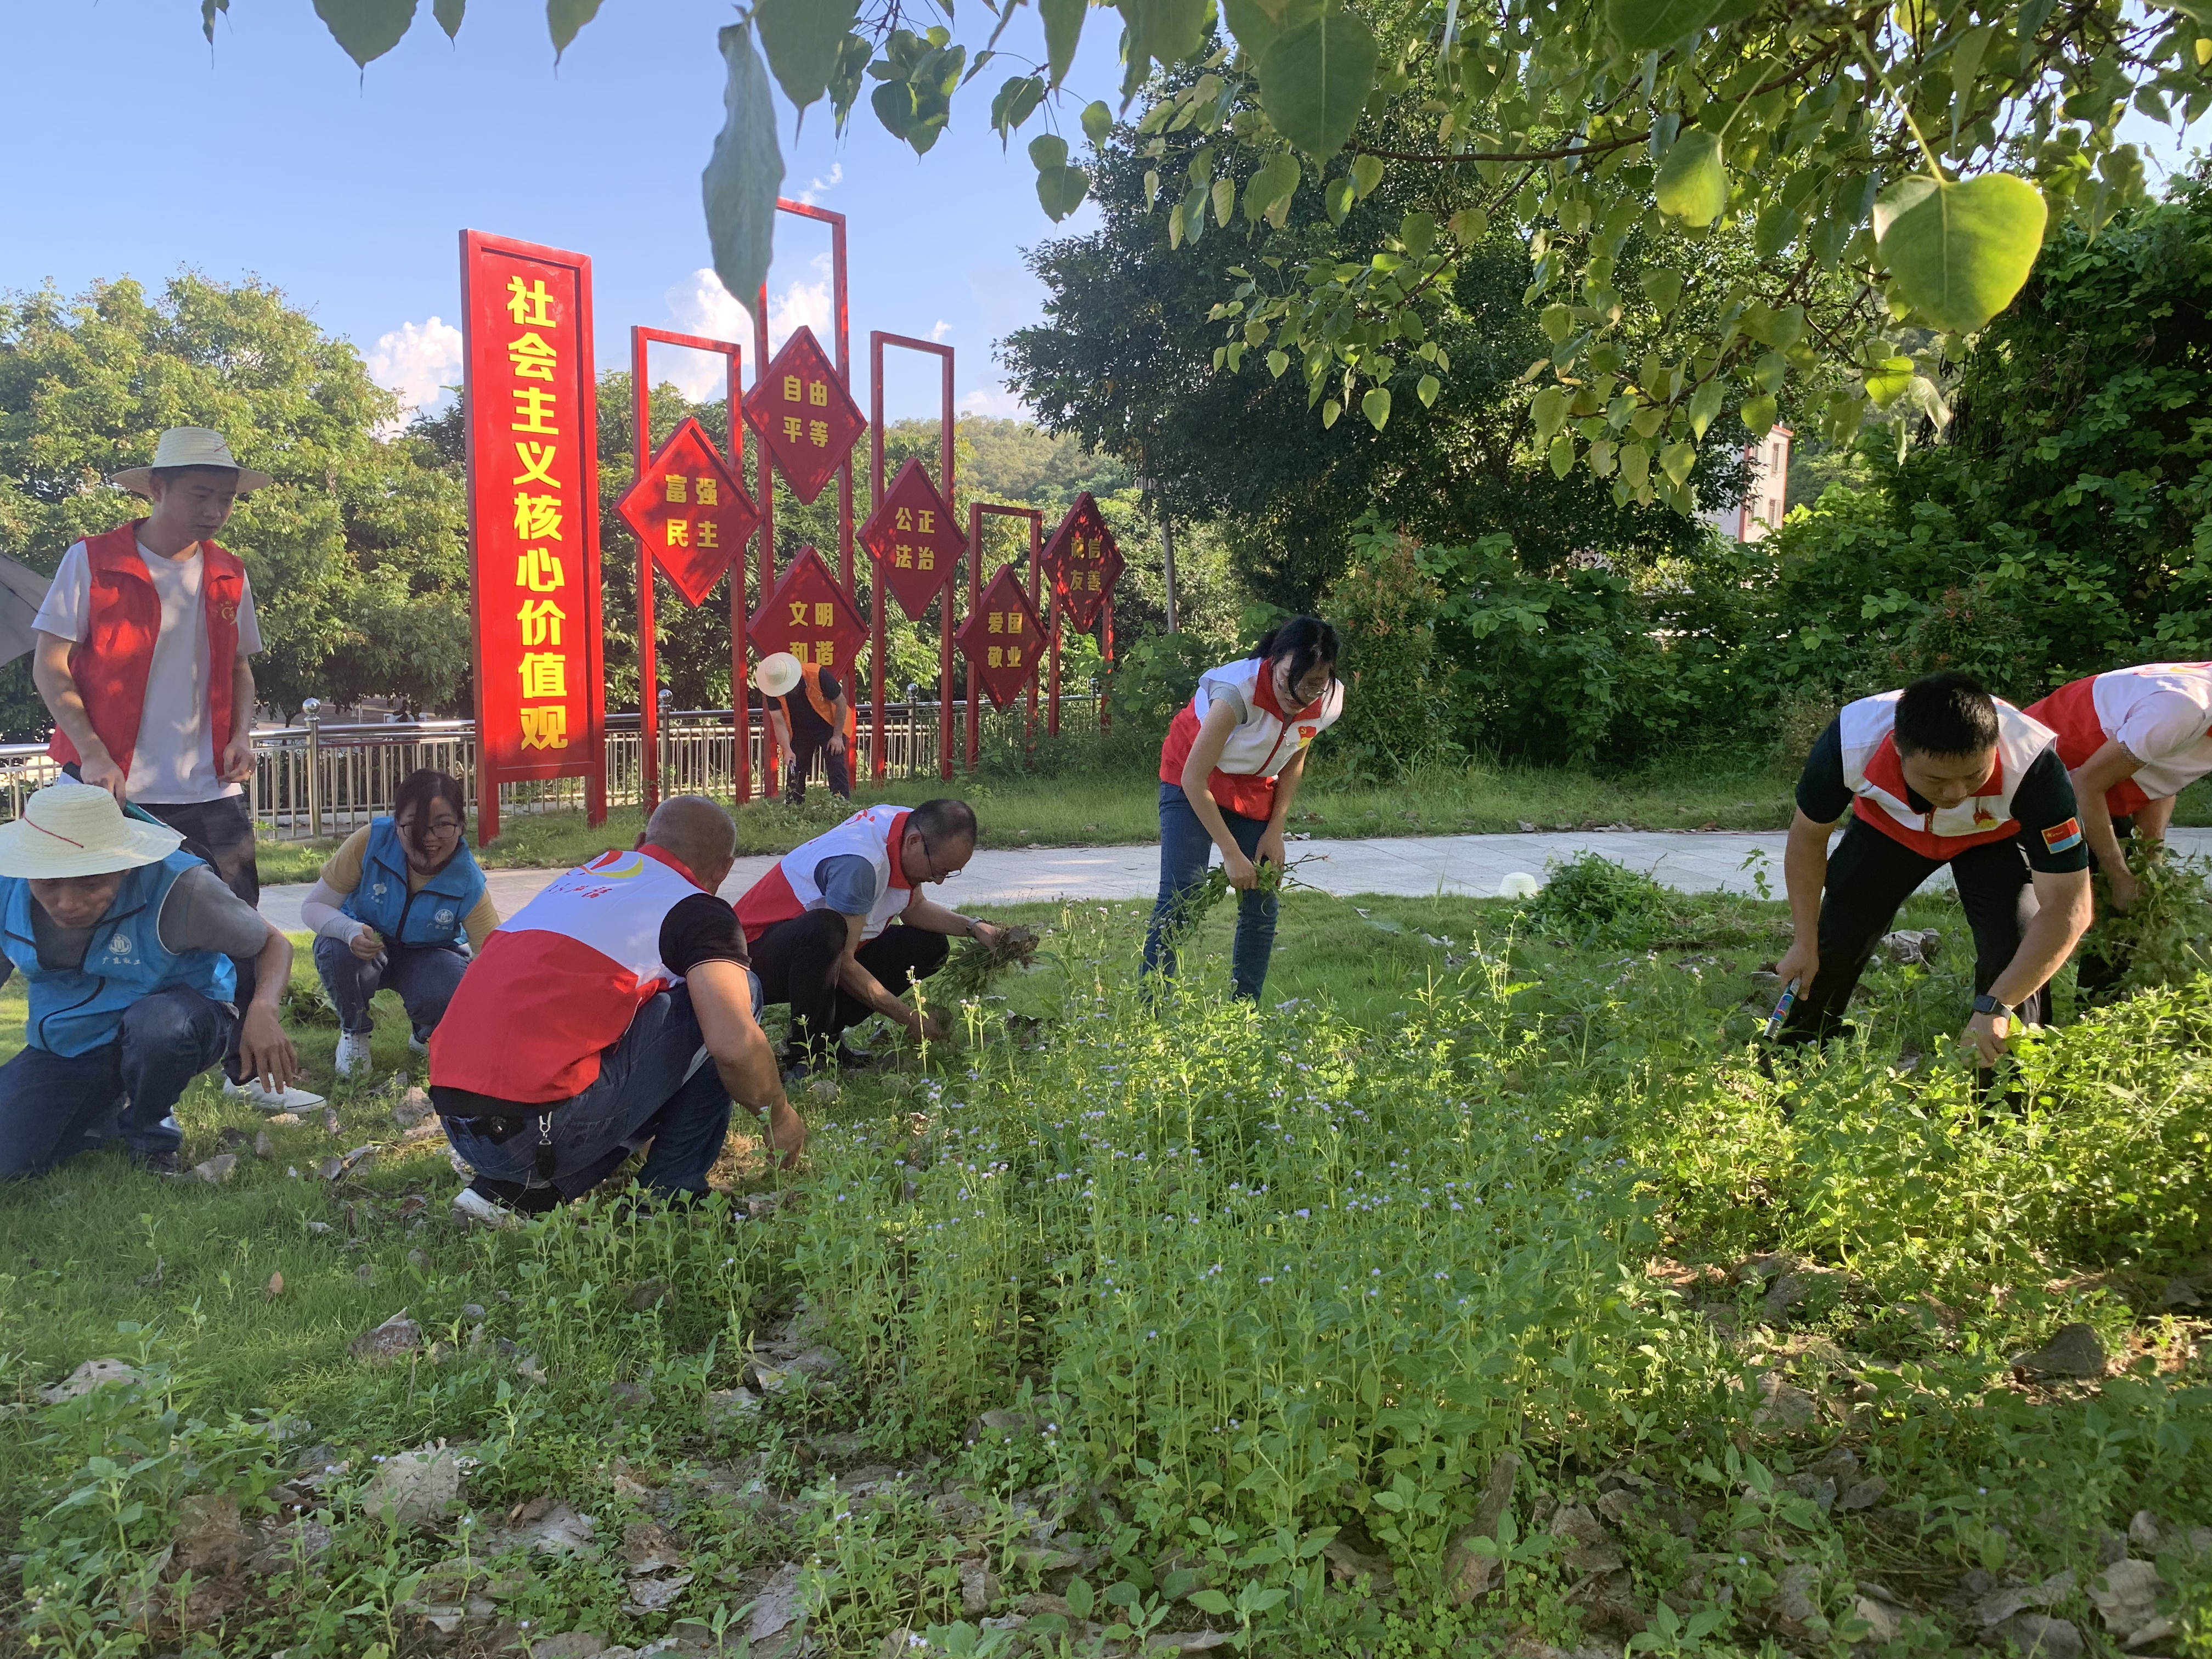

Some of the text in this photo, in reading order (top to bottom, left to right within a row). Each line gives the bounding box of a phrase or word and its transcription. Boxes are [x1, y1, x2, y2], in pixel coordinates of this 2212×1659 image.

[783, 375, 828, 408] 自由
[783, 416, 829, 448] 平等
[664, 474, 718, 506] 富强
[506, 275, 569, 750] 社会主义核心价值观
[895, 507, 935, 533] 公正
[666, 518, 719, 549] 民主
[895, 544, 935, 570] 法治
[1070, 537, 1101, 559] 诚信
[1070, 570, 1101, 591] 友善
[789, 601, 833, 627] 文明
[988, 612, 1023, 634] 爱国
[789, 641, 834, 666] 和谐
[988, 646, 1022, 668] 敬业
